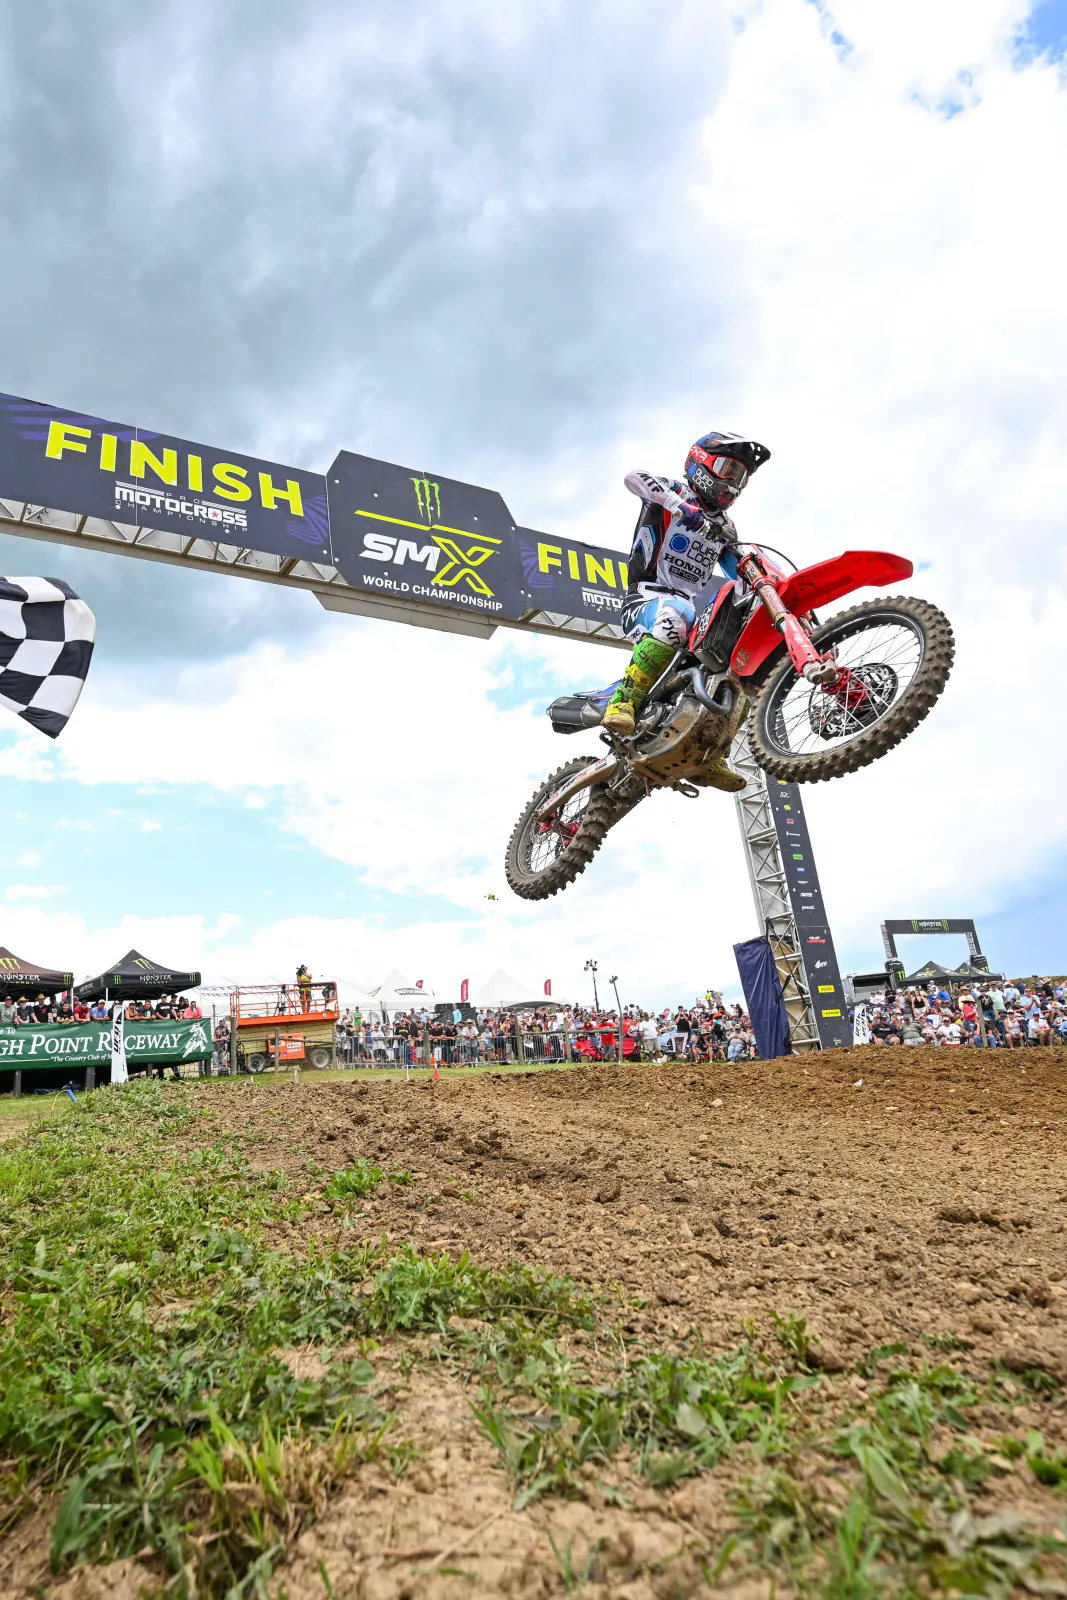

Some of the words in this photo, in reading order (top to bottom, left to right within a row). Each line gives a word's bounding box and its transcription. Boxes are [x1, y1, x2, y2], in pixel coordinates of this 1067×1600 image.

[45, 420, 304, 517] FINISH
[691, 474, 708, 493] LOCK
[114, 486, 248, 527] MOTOCROSS
[166, 492, 201, 505] PRO
[114, 499, 248, 532] CHAMPIONSHIP
[686, 549, 714, 571] LOCK
[690, 540, 720, 562] QUAD
[359, 532, 496, 597] SMX
[664, 553, 707, 580] HONDA
[363, 574, 410, 593] WORLD
[413, 584, 503, 612] CHAMPIONSHIP
[582, 591, 624, 609] MOTO
[139, 973, 172, 981] MONSTER
[6, 1026, 16, 1034] To
[28, 1033, 93, 1055] POINT
[96, 1031, 183, 1052] RCEWAY
[64, 1055, 87, 1063] Country
[100, 1053, 107, 1061] of
